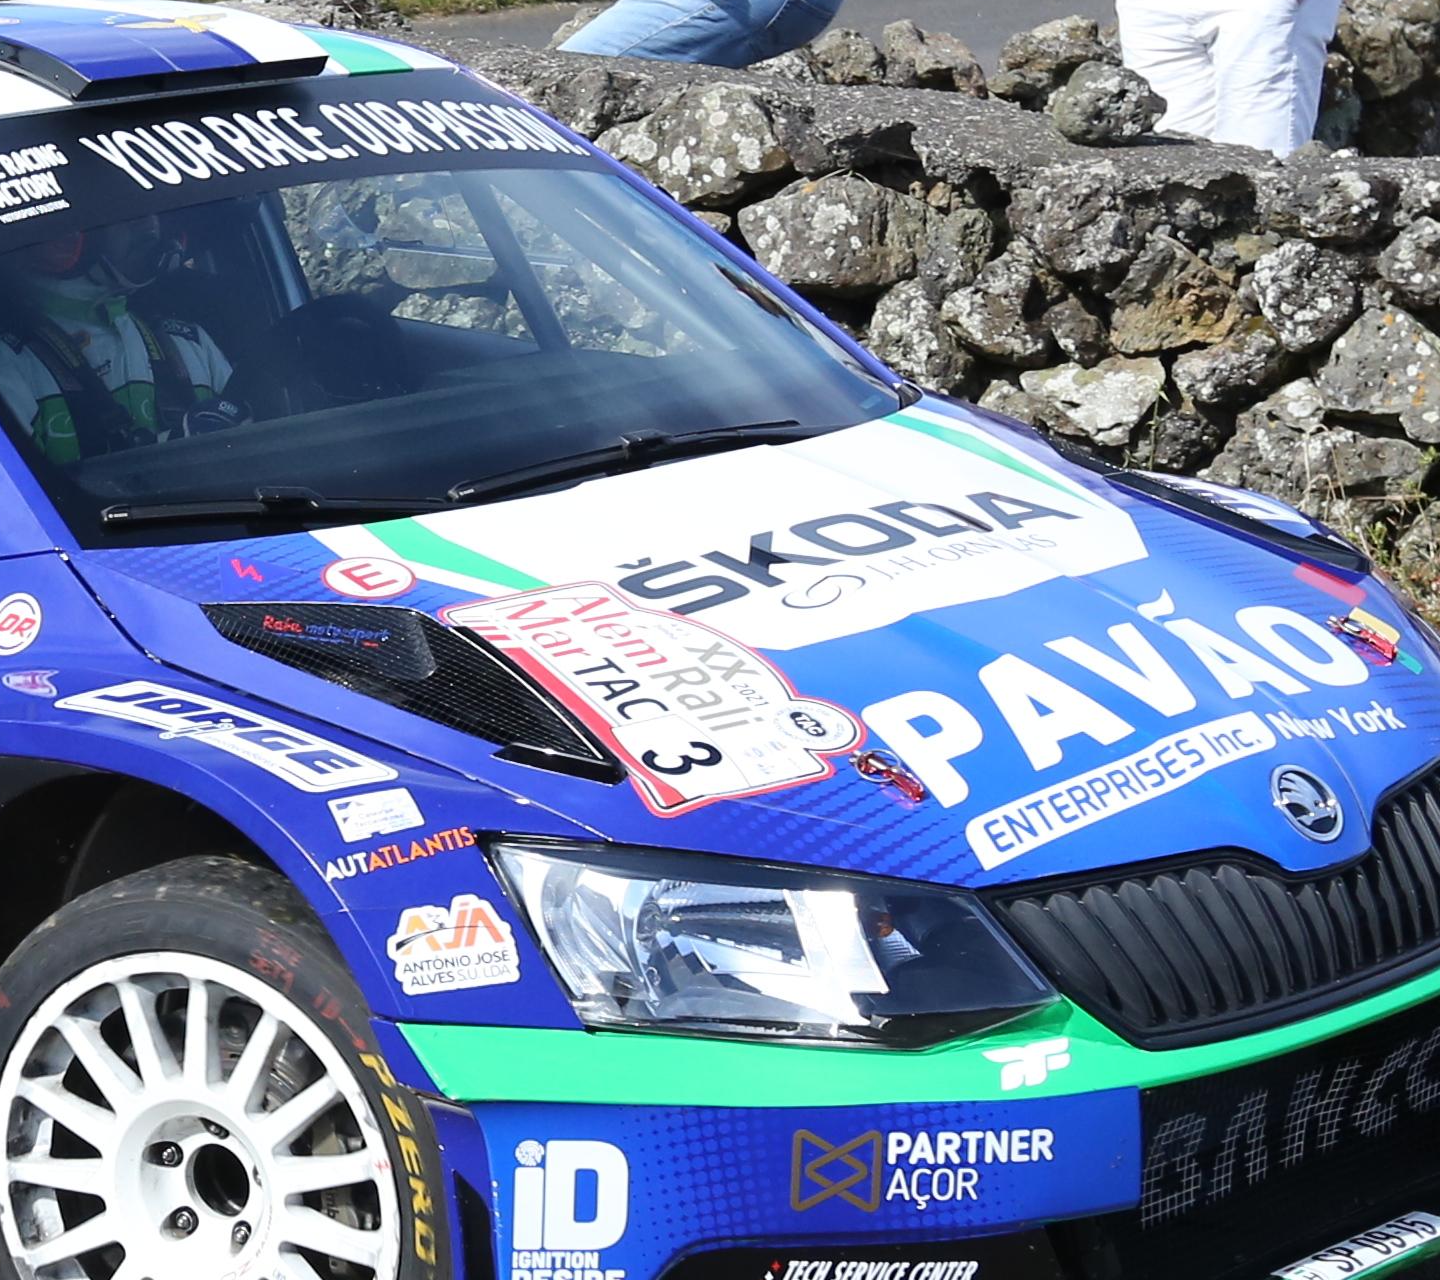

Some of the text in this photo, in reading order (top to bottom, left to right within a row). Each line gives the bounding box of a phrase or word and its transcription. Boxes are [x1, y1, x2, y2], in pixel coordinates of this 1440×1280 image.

[0, 143, 70, 178] RACING
[78, 120, 246, 190] YOUR
[201, 107, 360, 170] RACE.
[319, 101, 444, 155] OUR
[615, 491, 1084, 616] ŠKODA
[928, 534, 1058, 562] ORNLAS
[339, 563, 398, 591] E
[554, 595, 669, 668] Além
[496, 599, 669, 720] Mar TAC
[684, 641, 762, 682] XX
[650, 665, 763, 732] Rali
[731, 681, 769, 708] 2021
[861, 587, 1370, 809] PAVÃO
[641, 740, 723, 776] 3
[983, 700, 1408, 854] ENTERPRISES Inc. New York
[401, 902, 504, 956] AJA
[475, 946, 511, 966] JOSÉ
[411, 970, 455, 988] ALVES
[886, 1127, 1055, 1166] PARTNER
[380, 1093, 436, 1266] ZERO
[885, 1168, 980, 1209] AÇOR
[512, 1250, 600, 1270] IGNITION
[1311, 1246, 1364, 1272] SP
